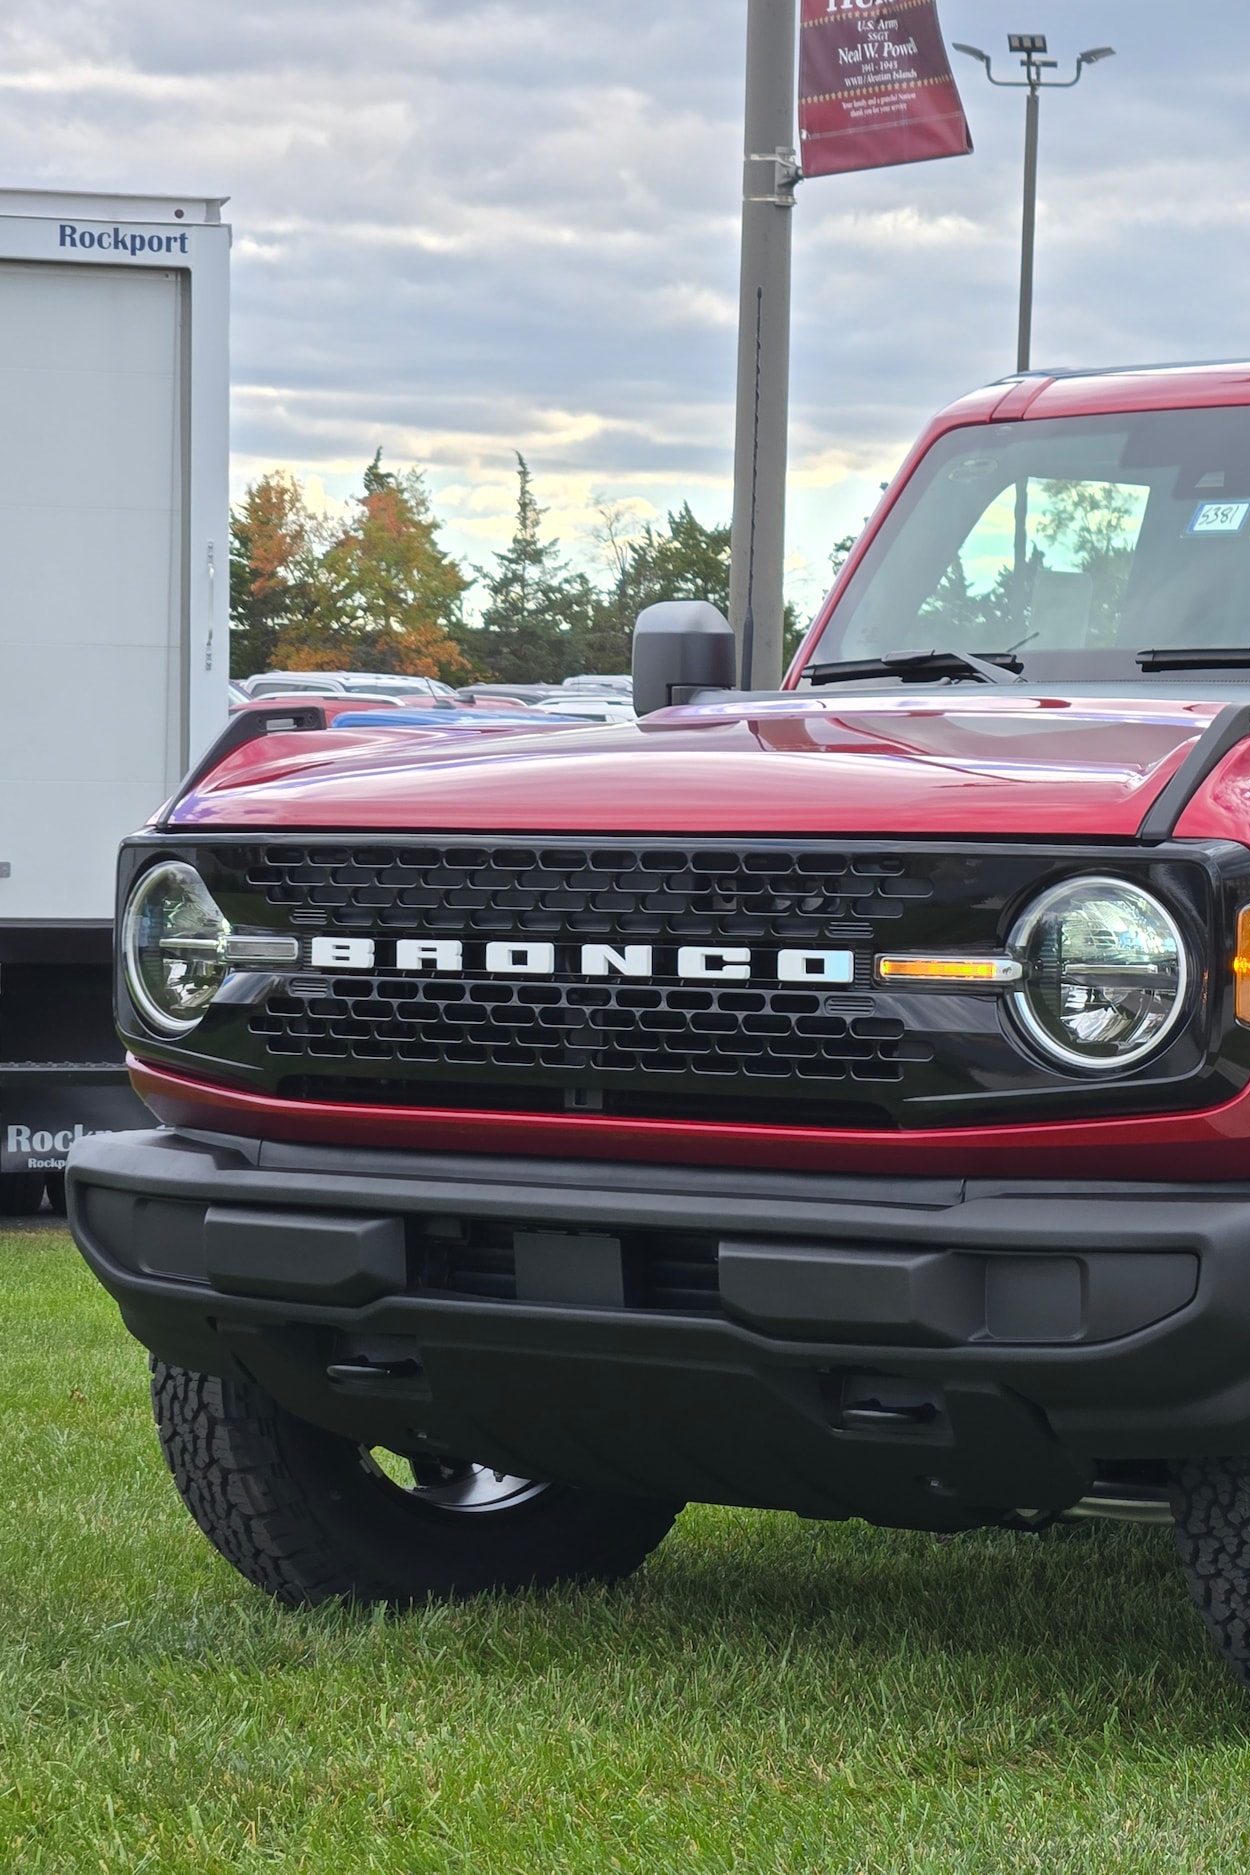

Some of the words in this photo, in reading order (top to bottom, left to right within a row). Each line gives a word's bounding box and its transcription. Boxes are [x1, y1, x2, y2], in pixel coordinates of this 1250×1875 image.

[857, 19, 874, 31] U.S.
[877, 19, 899, 30] Army
[867, 31, 889, 41] SSGT
[838, 44, 863, 64] Neal
[863, 42, 879, 59] W.
[883, 36, 918, 58] Powell
[892, 68, 918, 80] Islands
[59, 224, 189, 256] Rockport
[1199, 505, 1240, 526] 5381
[311, 936, 855, 984] BRONCO
